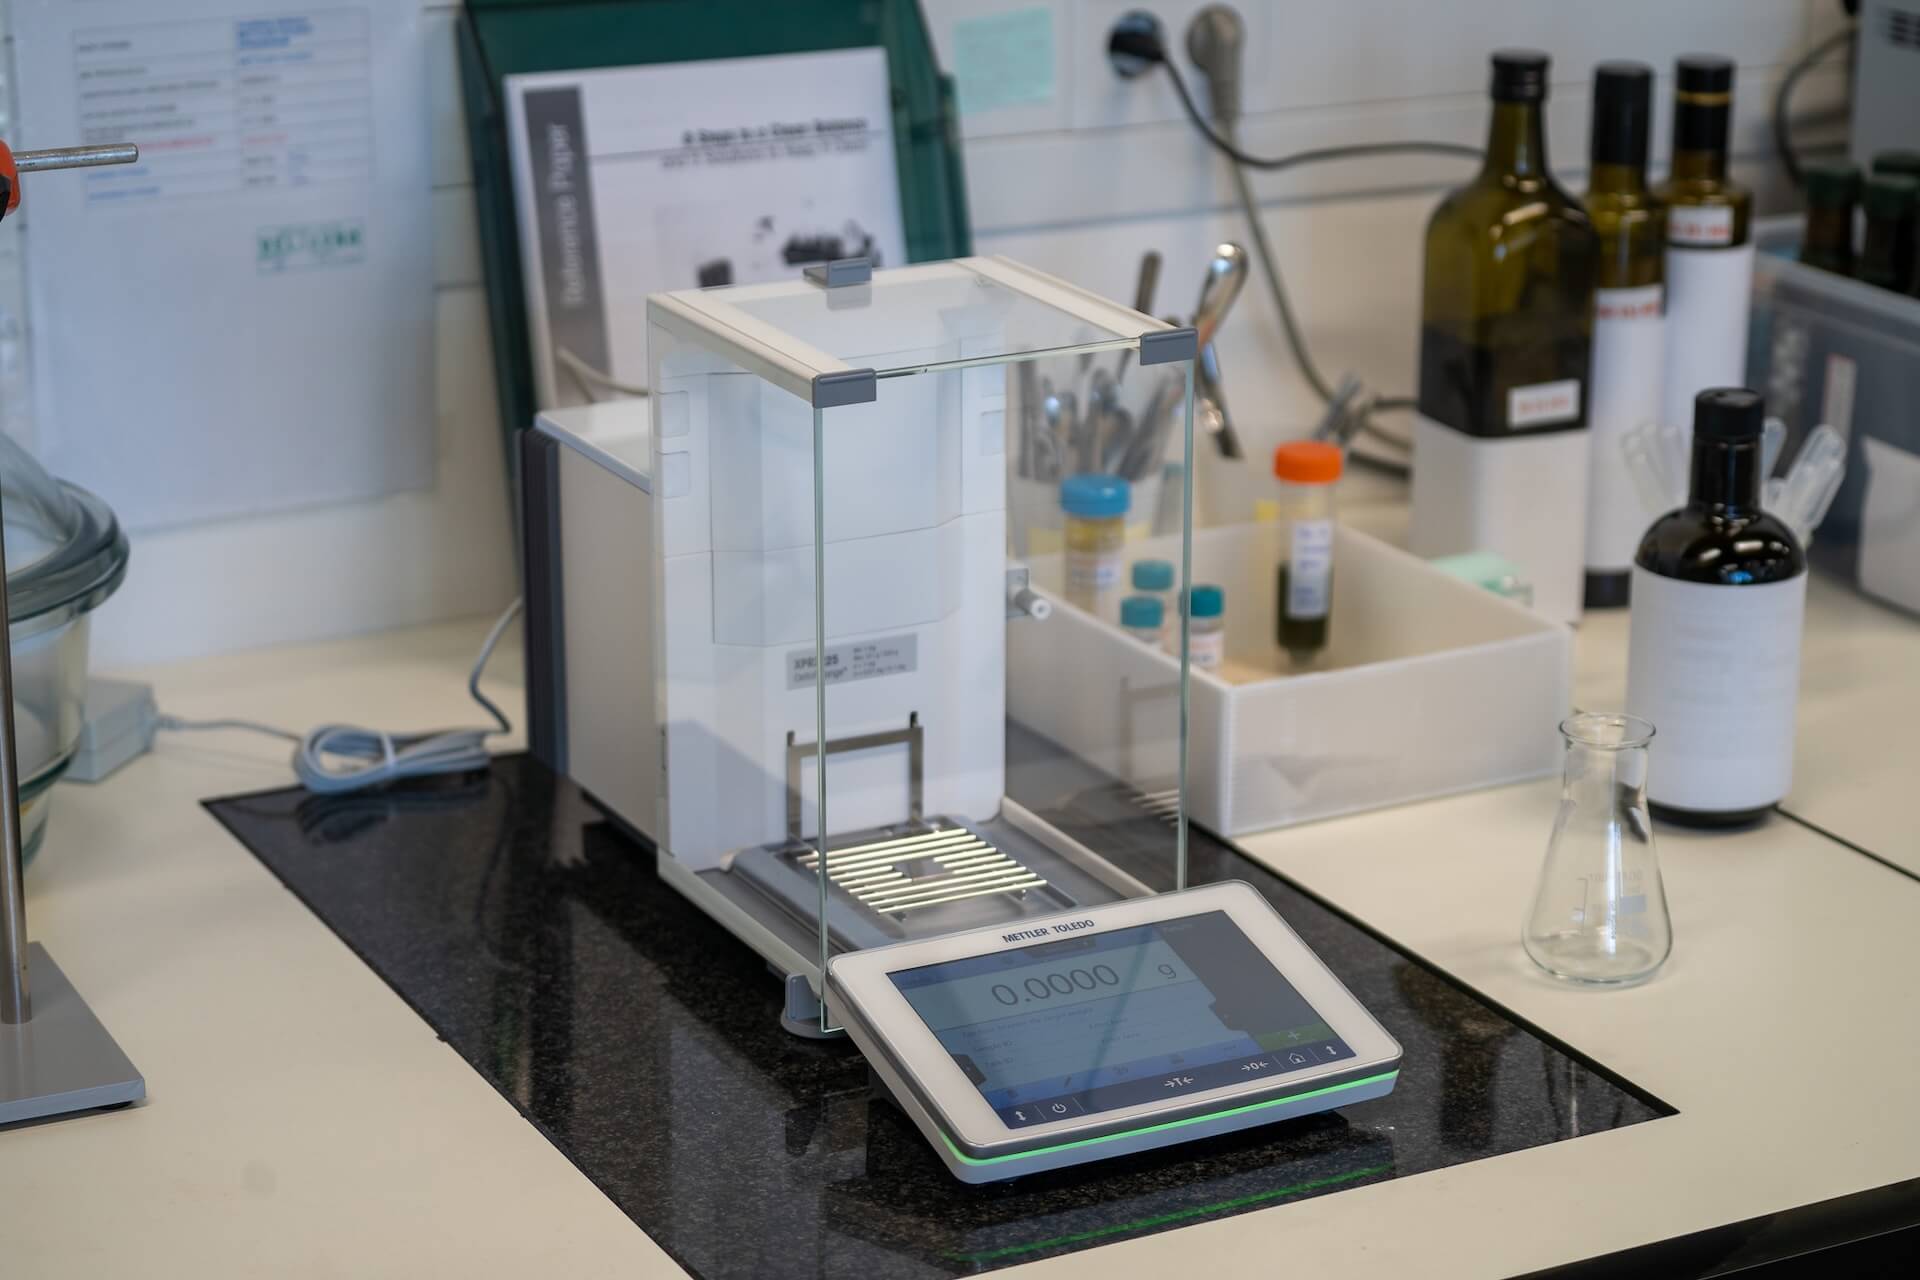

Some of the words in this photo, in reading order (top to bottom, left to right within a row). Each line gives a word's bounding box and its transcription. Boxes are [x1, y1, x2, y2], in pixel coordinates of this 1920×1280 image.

[1002, 927, 1050, 943] METTLER
[1052, 919, 1095, 934] TOLEDO
[991, 964, 1120, 1006] 0.0000
[1158, 964, 1177, 979] g
